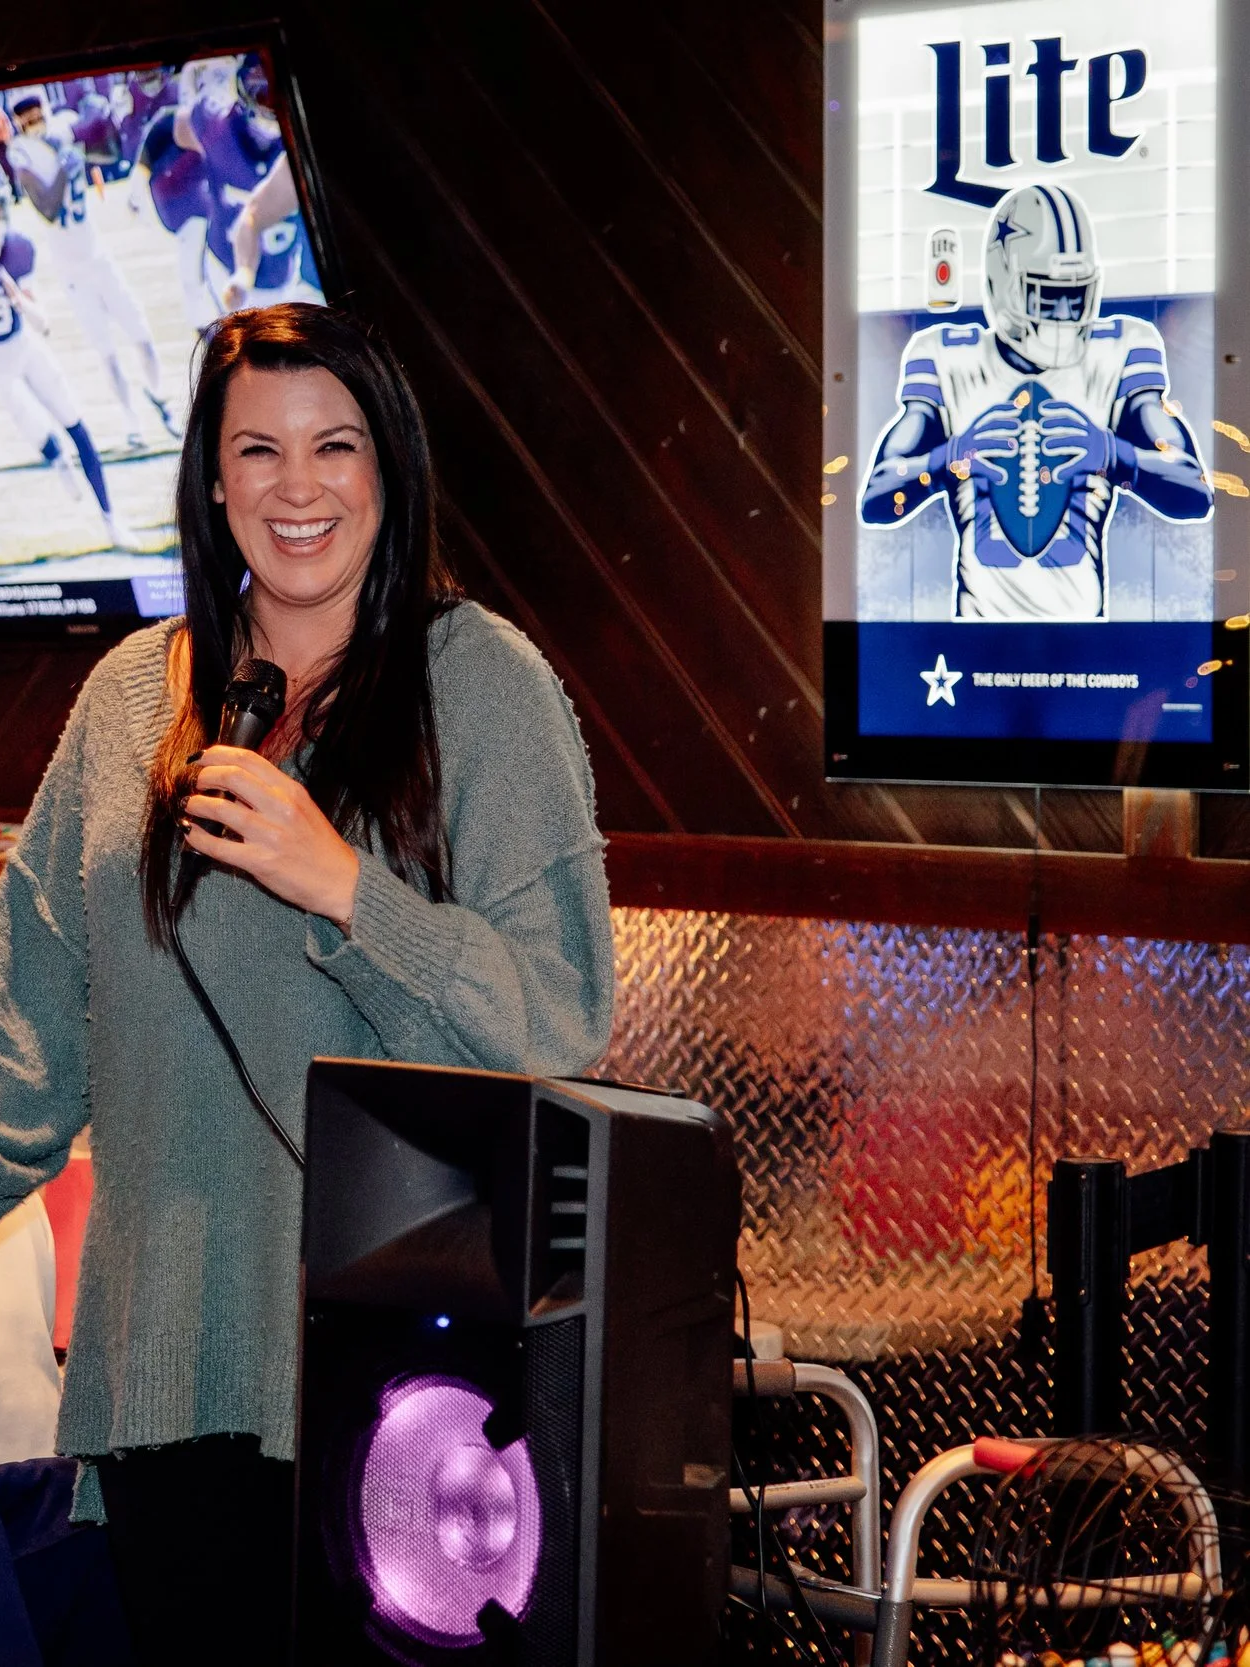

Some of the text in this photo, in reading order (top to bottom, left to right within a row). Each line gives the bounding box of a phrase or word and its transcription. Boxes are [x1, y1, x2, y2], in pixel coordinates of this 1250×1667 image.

[923, 37, 1148, 208] Lite
[931, 239, 958, 258] Lite
[972, 671, 1140, 689] THE ONLY BEER OF THE COWBOYS
